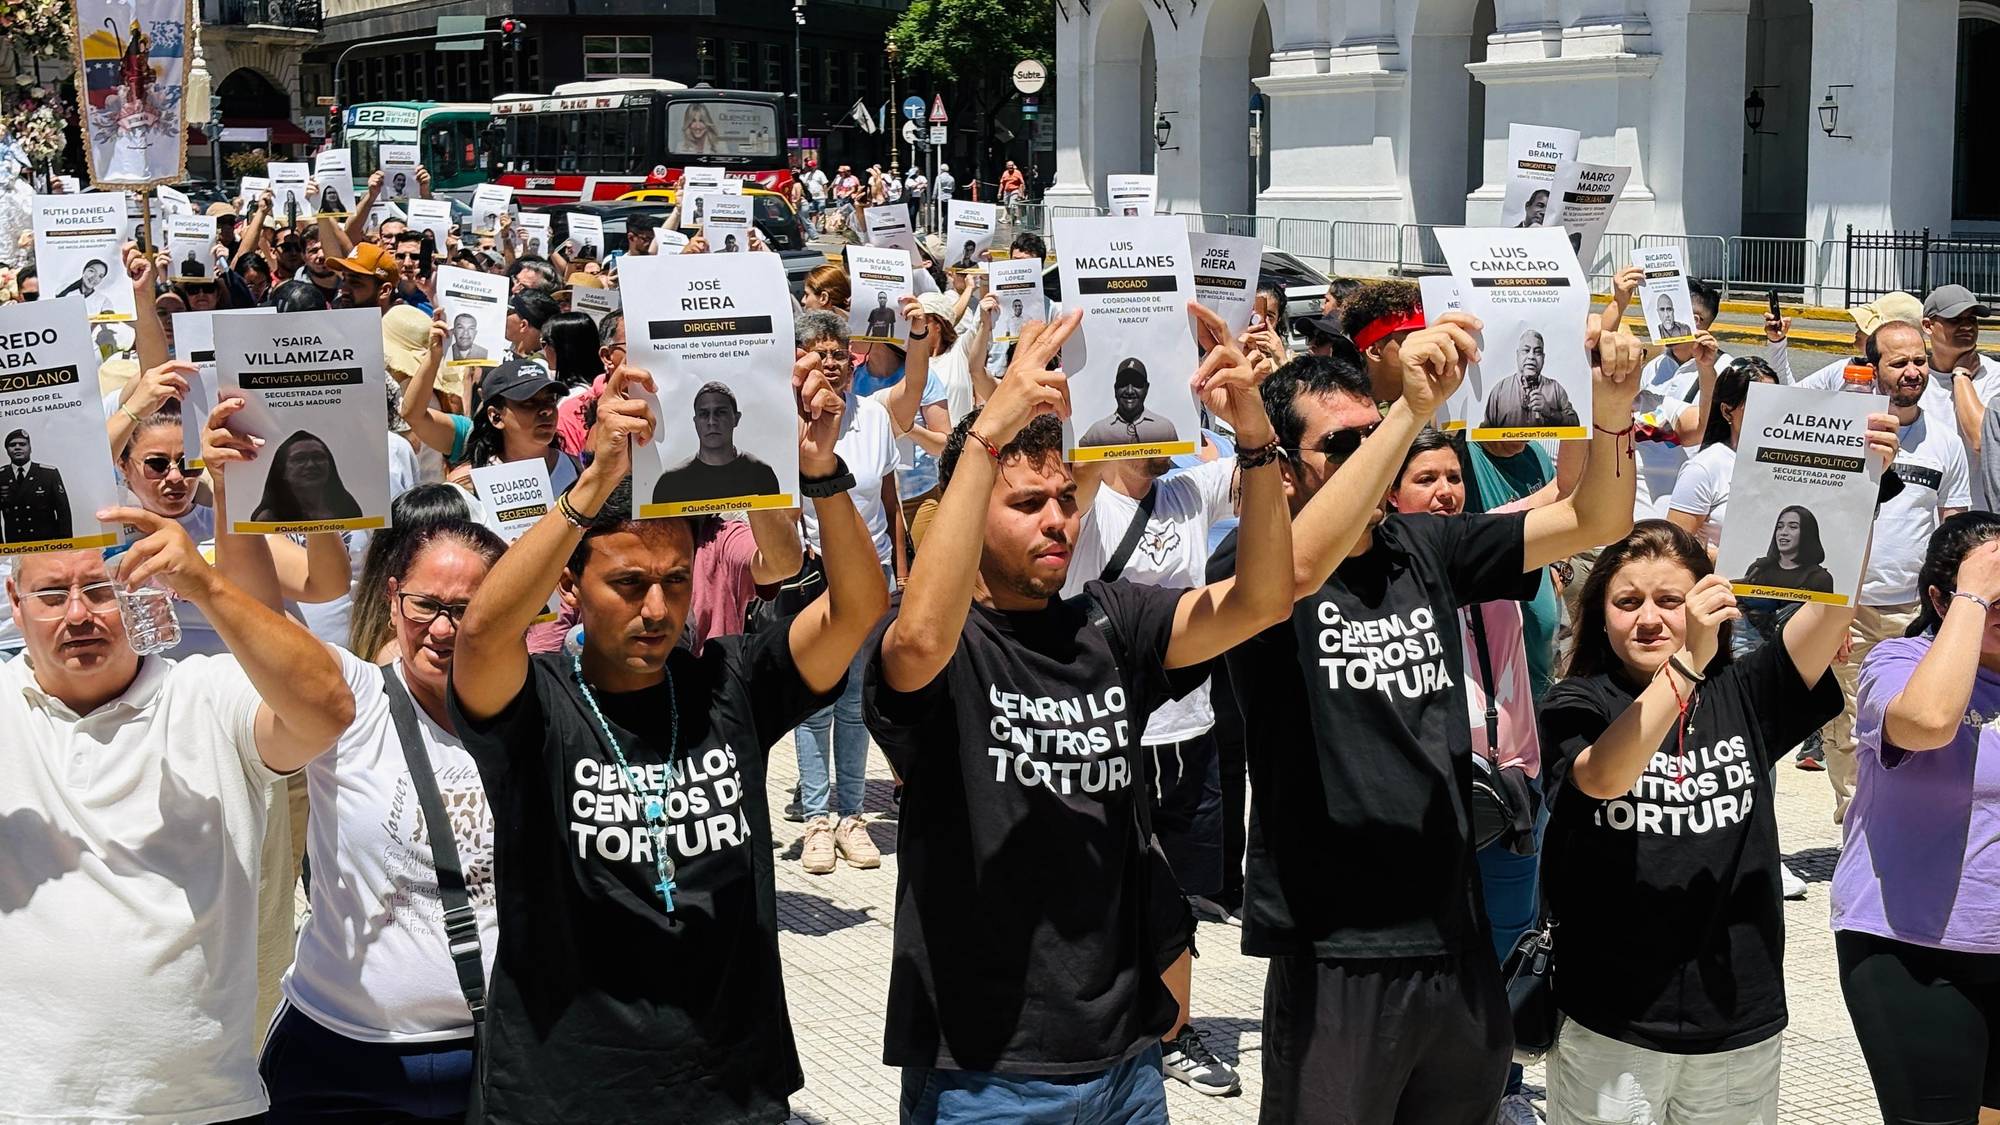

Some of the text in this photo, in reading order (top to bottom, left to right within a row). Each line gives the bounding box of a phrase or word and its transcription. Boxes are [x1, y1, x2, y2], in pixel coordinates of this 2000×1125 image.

[1017, 70, 1041, 79] Subte
[358, 110, 385, 122] 22
[386, 110, 417, 118] QUILMES
[1537, 141, 1557, 150] EMIL
[1528, 149, 1564, 160] BRANDT
[656, 167, 666, 176] 60
[1580, 170, 1615, 182] MARCO
[1577, 182, 1611, 192] MADRID
[43, 206, 115, 216] RUTH DANIELA
[56, 216, 105, 225] MORALES
[1109, 241, 1134, 251] LUIS
[1489, 247, 1528, 259] LUIS
[1644, 253, 1673, 261] RICARDO
[875, 258, 905, 266] CARLOS
[1075, 255, 1175, 270] MAGALLANES
[1201, 258, 1236, 270] RIERA
[1469, 261, 1560, 272] CAMACARO
[687, 278, 722, 291] JOSÉ
[1106, 279, 1148, 289] ABOGADO
[681, 296, 735, 311] RIERA
[1102, 296, 1151, 304] COORDINADOR
[1152, 305, 1174, 313] VENTE
[683, 321, 737, 333] DIRIGENTE
[0, 328, 58, 350] REDO
[272, 336, 322, 348] YSAIRA
[653, 341, 688, 351] Nacional
[689, 341, 699, 349] de
[701, 339, 737, 348] Voluntad
[738, 338, 769, 348] Popular
[245, 349, 355, 366] VILLAMIZAR
[681, 350, 750, 360] miembro del ENA
[0, 370, 71, 391] ZOLANO
[251, 371, 350, 385] ACTIVISTA POLÍTICO
[264, 388, 342, 399] SECUESTRADA POR
[0, 396, 30, 407] TRADO
[32, 394, 50, 402] POR
[44, 400, 82, 412] MADURO
[268, 398, 342, 408] NICOLÁS MADURO
[1783, 413, 1853, 431] ALBANY
[1763, 427, 1864, 448] COLMENARES
[1103, 447, 1162, 458] #QueSeanTodos
[1761, 451, 1859, 469] ACTIVISTA POLÍTICO
[1772, 466, 1829, 479] SECUESTRADA
[490, 477, 539, 495] EDUARDO
[1809, 478, 1844, 488] MADURO
[494, 489, 543, 506] LABRADOR
[681, 501, 753, 513] #QueSeanTodos
[499, 506, 547, 521] SECUESTRADO
[274, 523, 345, 533] #QueSeanTodos
[1750, 589, 1812, 600] #QueSeanTodos
[1424, 632, 1444, 656] D
[1319, 658, 1455, 703] TOTURA
[1700, 735, 1747, 769] LOS
[687, 743, 737, 783] LOS
[1724, 760, 1755, 790] DE
[713, 770, 744, 807] DE
